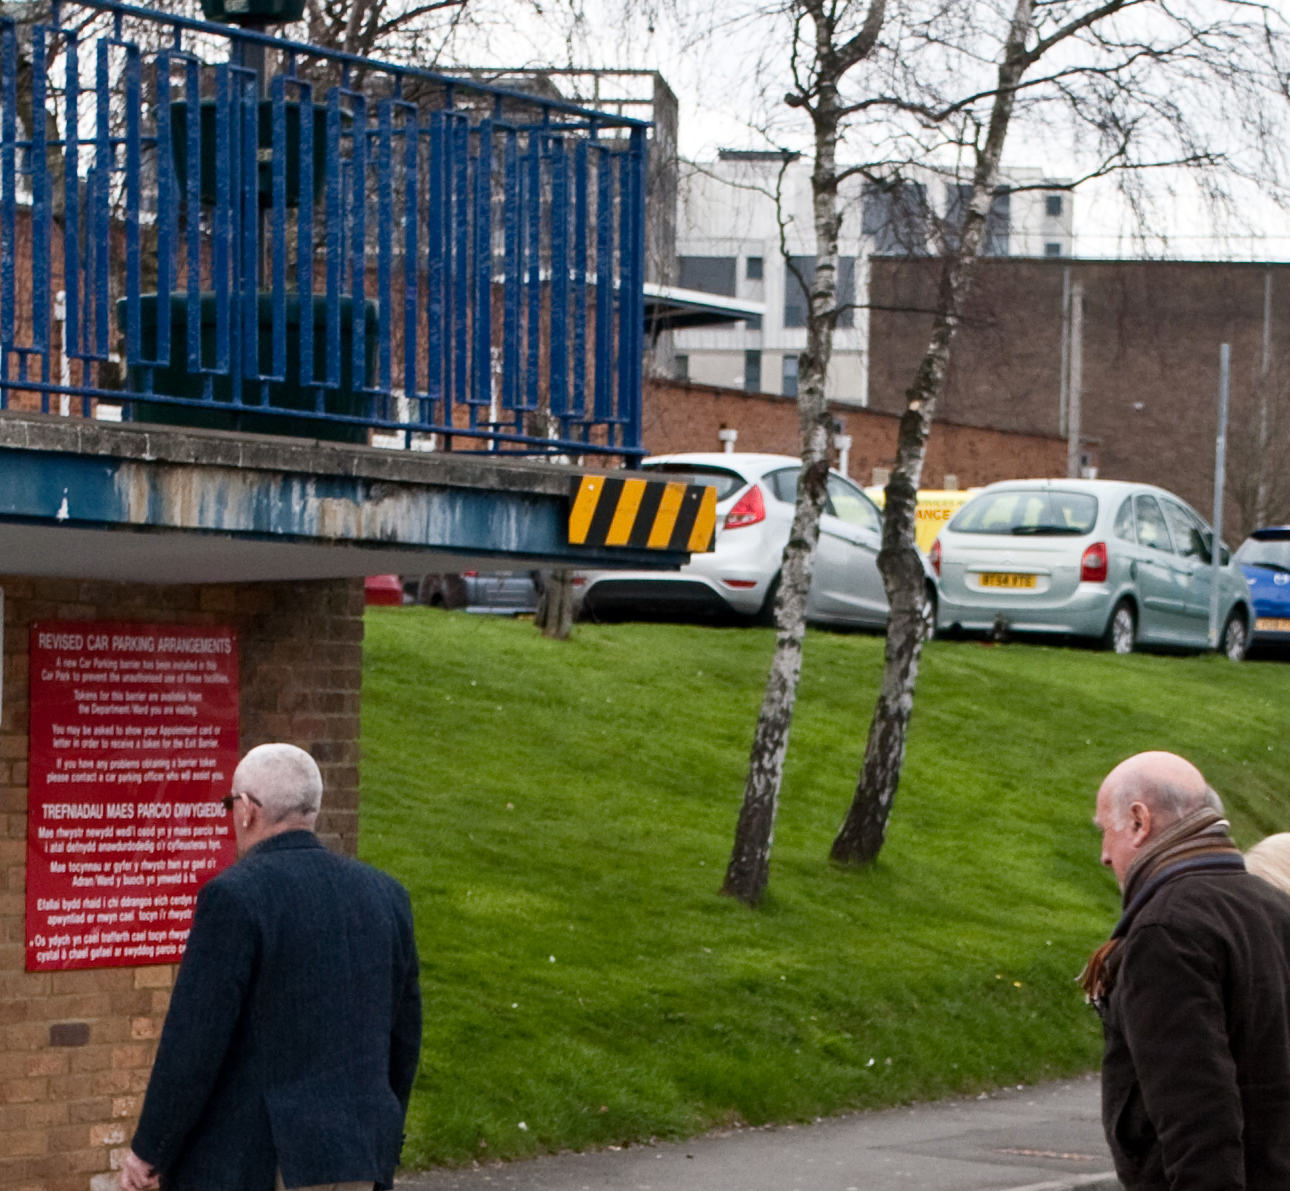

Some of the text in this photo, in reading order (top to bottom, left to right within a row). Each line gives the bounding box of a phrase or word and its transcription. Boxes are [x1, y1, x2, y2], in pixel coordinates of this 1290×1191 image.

[39, 632, 231, 654] REVISED CAR PARKING ARRANGEMENTS
[79, 657, 91, 669] Car
[93, 657, 118, 671] Parking
[41, 668, 54, 681] Car
[55, 669, 70, 682] Park
[74, 688, 98, 701] Tokens
[150, 706, 162, 717] you
[52, 723, 65, 735] You
[66, 726, 81, 737] may
[82, 724, 92, 736] be
[64, 760, 77, 771] you
[78, 758, 95, 770] have
[96, 760, 109, 772] any
[110, 758, 141, 772] problems
[46, 771, 70, 785] please
[71, 772, 98, 783] contact
[117, 772, 143, 785] parking
[143, 771, 165, 782] officer
[42, 802, 228, 819] TREFNIADAU MAES PARCIO DIWYGIEDIG
[38, 826, 55, 839] Mae
[85, 825, 115, 840] newydd
[193, 826, 214, 838] parcio
[50, 860, 67, 873] Mae
[61, 897, 82, 912] bydd
[83, 897, 102, 909] rhaid
[170, 894, 193, 907] cerdyn
[97, 912, 118, 925] mwyn
[119, 909, 135, 922] cael
[139, 909, 159, 923] tocyn
[35, 934, 46, 948] Os
[49, 932, 71, 949] ydych
[83, 930, 100, 945] cael
[131, 929, 147, 942] cael
[147, 930, 168, 943] tocyn
[155, 943, 177, 957] parcio
